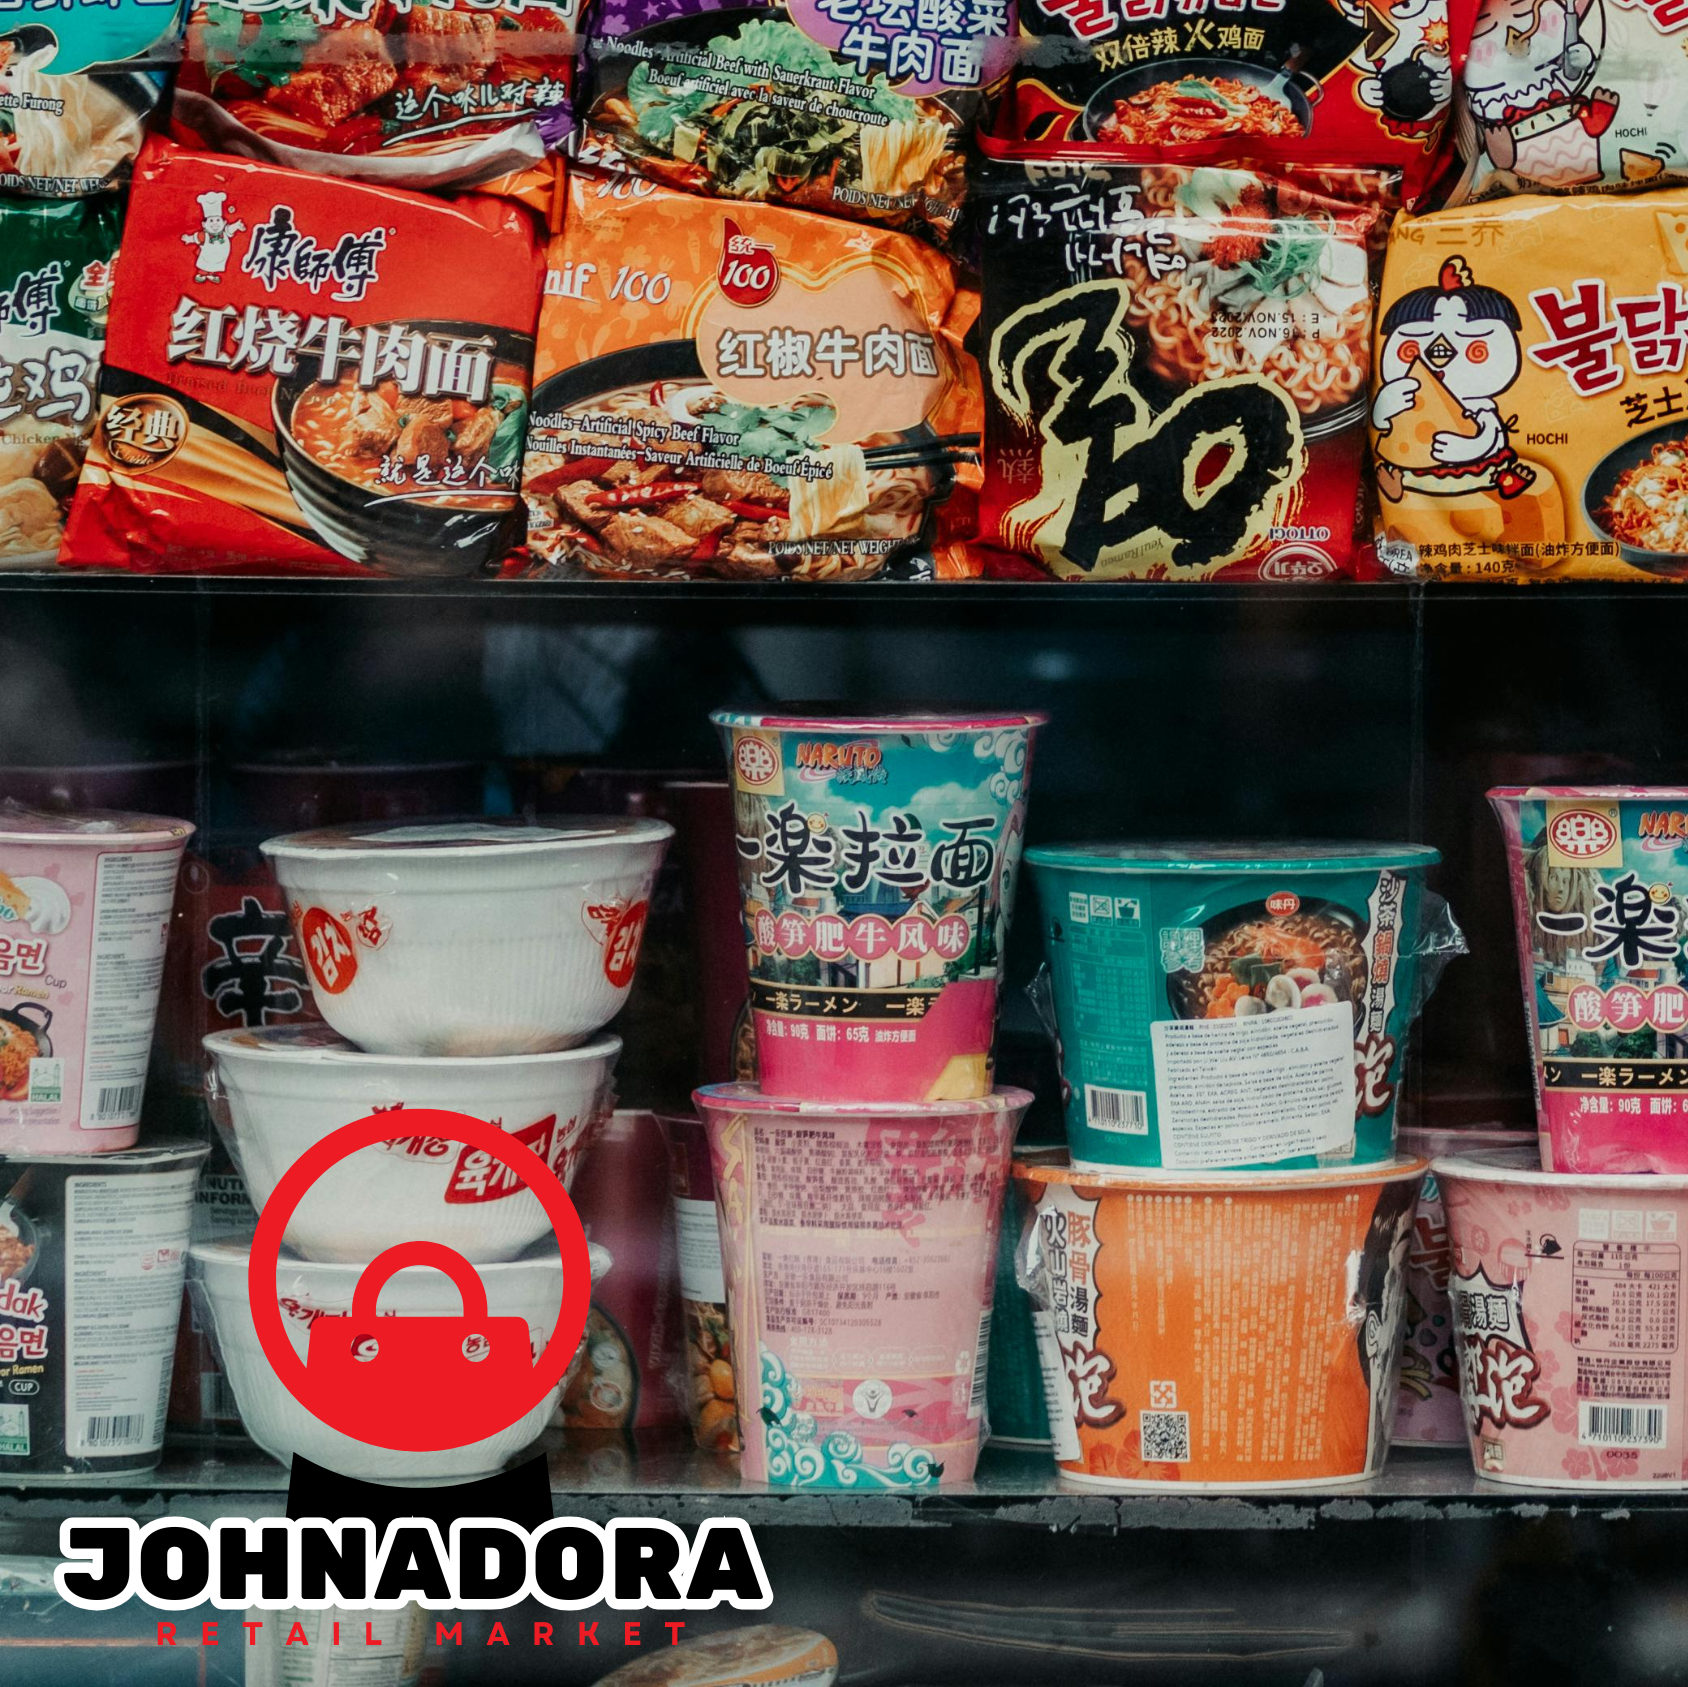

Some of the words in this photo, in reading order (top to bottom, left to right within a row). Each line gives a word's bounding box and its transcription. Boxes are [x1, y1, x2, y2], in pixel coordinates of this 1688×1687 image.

[841, 26, 983, 84] 牛肉面
[1095, 18, 1266, 71] 双倍辣火鸡面
[1615, 126, 1648, 138] HOCHI
[243, 204, 387, 301] 康師傅
[723, 263, 768, 290] 100
[166, 297, 496, 402] 红烧牛肉面
[718, 328, 938, 379] 红椒牛肉面
[635, 419, 668, 442] Spicy
[671, 426, 699, 442] Beef
[701, 428, 739, 446] Flavor
[1526, 432, 1568, 446] HOCHI
[1269, 526, 1331, 541] OTTOGI
[795, 741, 882, 769] NARUTO
[756, 918, 966, 954] 酸笋肥牛风味
